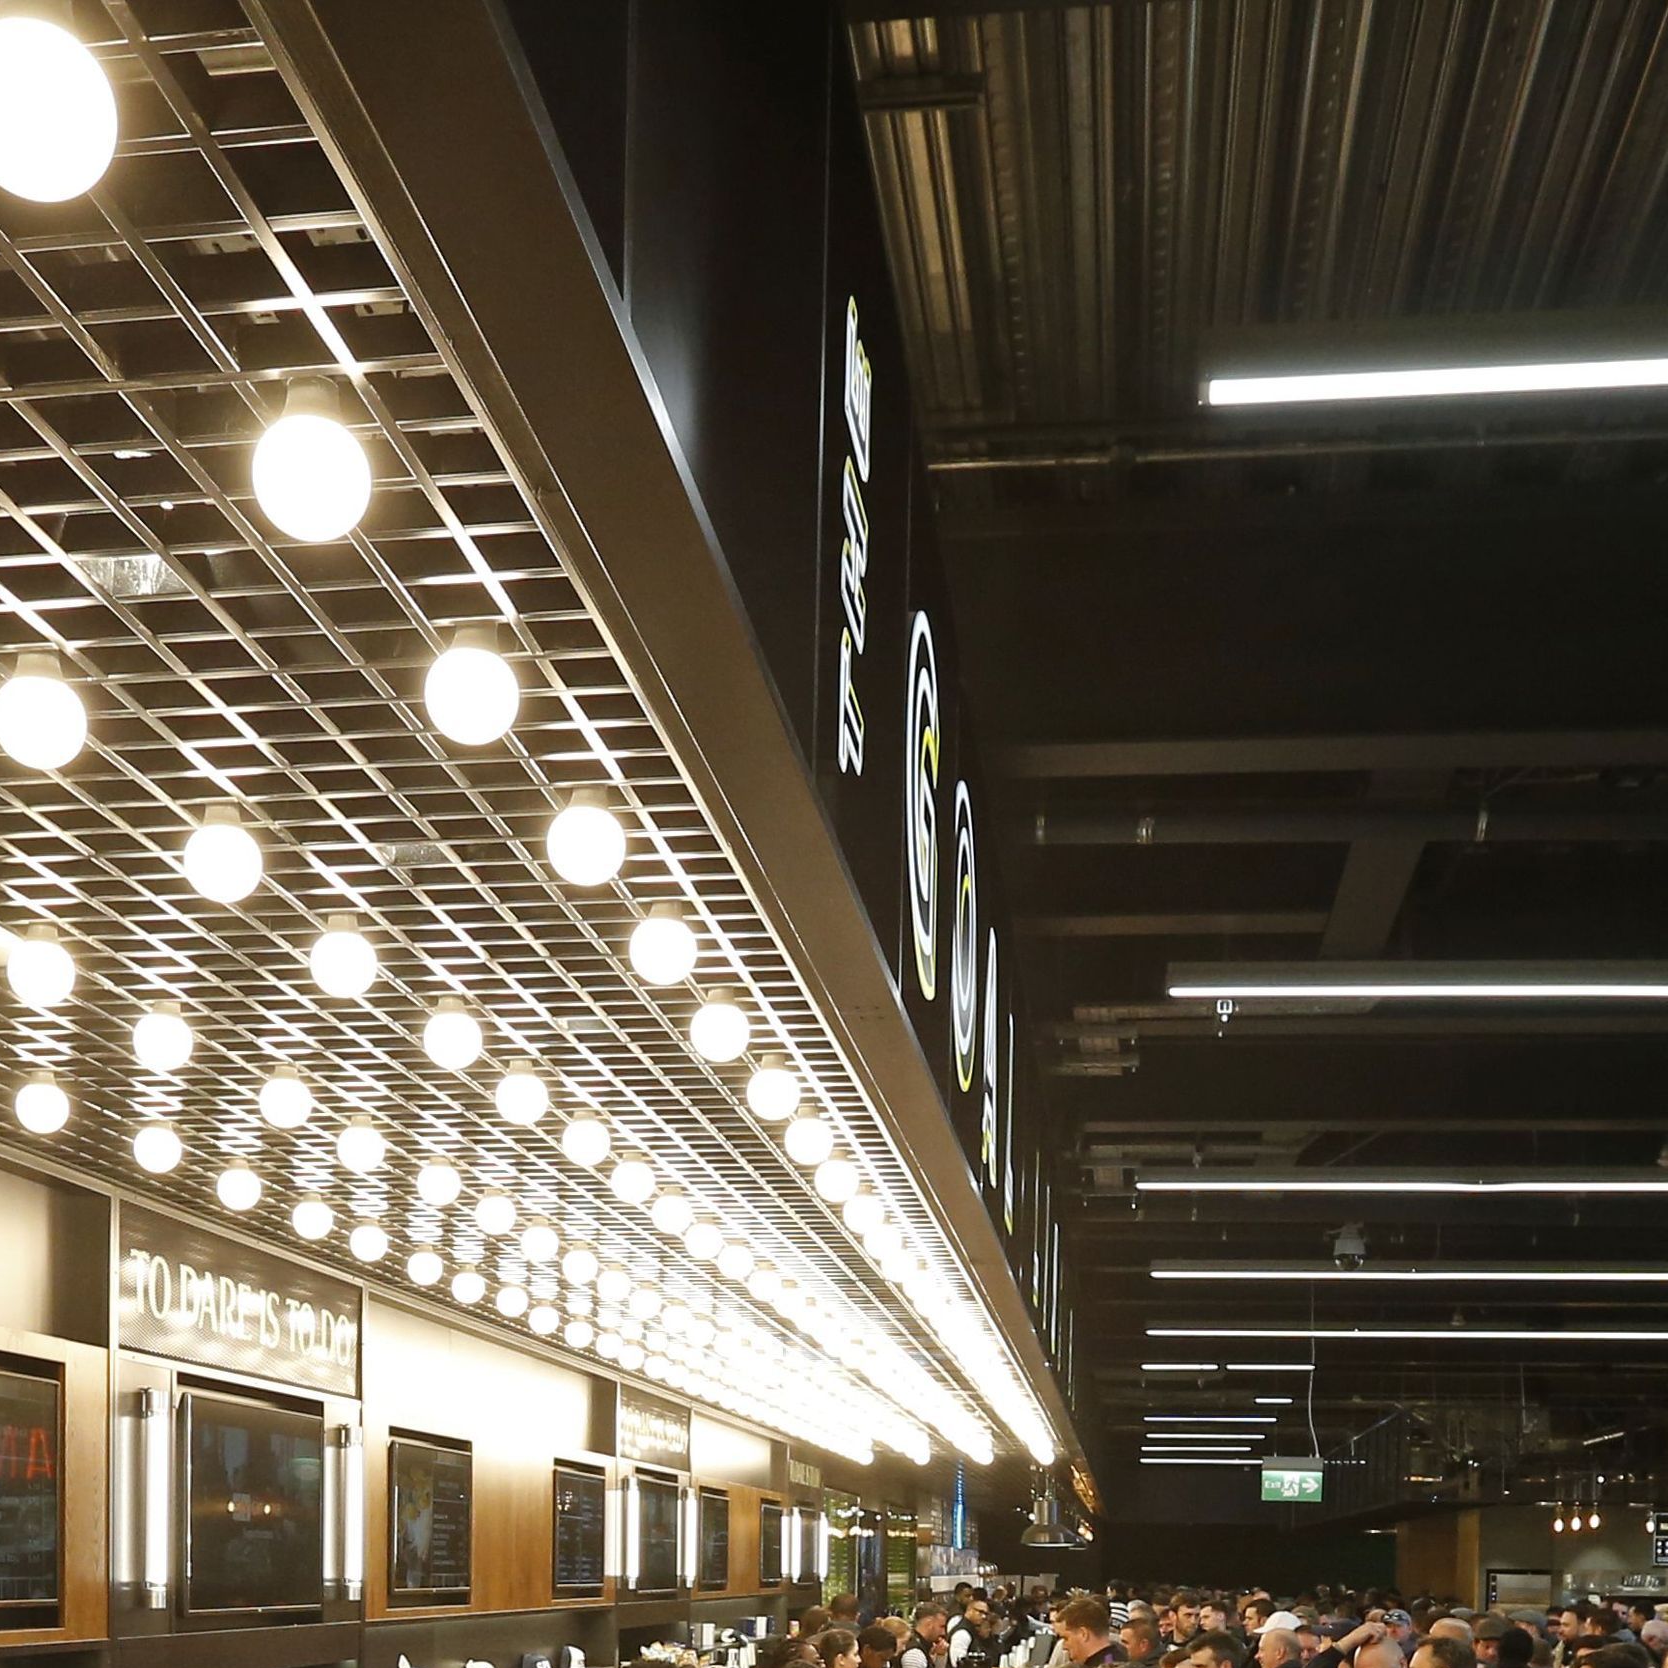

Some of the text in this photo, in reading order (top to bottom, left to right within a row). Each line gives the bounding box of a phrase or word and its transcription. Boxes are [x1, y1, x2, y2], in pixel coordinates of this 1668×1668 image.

[839, 295, 871, 777] THE
[905, 609, 1014, 1236] GOAL
[130, 1249, 353, 1367] TO DARE IS TO DO
